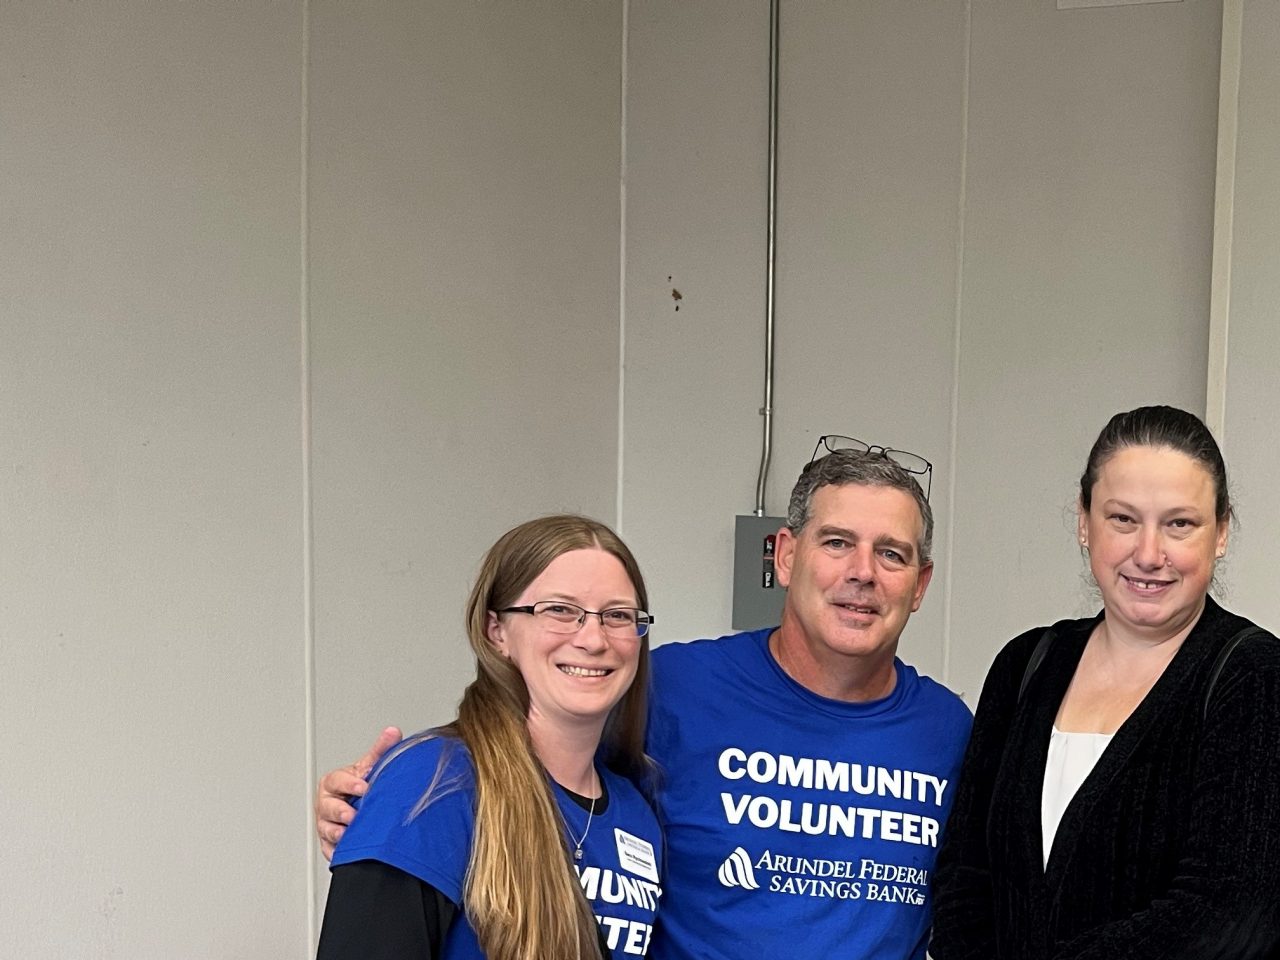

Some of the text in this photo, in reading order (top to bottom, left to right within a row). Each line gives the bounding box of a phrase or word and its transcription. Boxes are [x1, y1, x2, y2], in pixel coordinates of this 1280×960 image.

[718, 747, 948, 807] COMMUNITY
[720, 792, 940, 848] VOLUNTEER
[755, 849, 928, 886] ARUNDEL FEDERAL
[769, 875, 861, 900] SAVINGS
[867, 883, 918, 905] BANK
